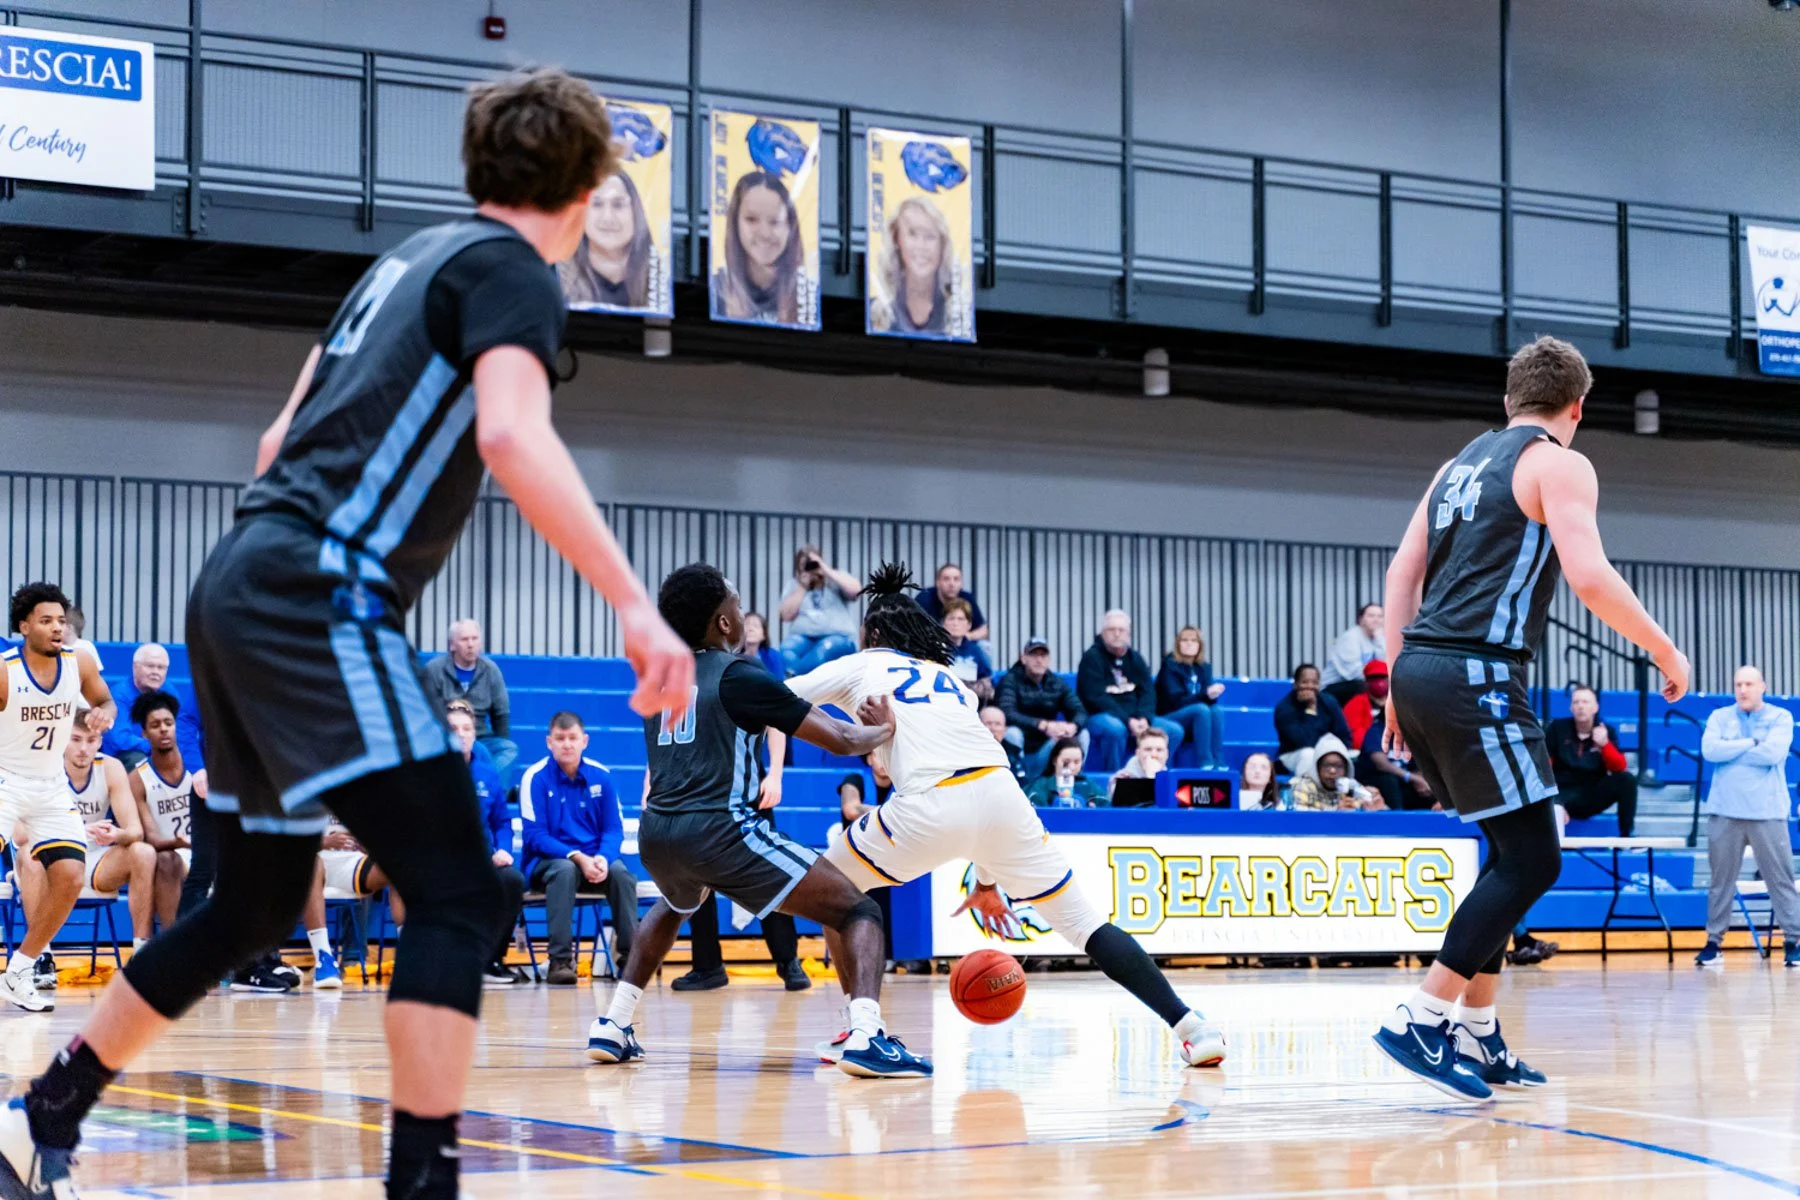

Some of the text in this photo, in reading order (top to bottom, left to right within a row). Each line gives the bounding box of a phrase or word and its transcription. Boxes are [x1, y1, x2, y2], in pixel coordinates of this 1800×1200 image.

[8, 125, 87, 163] Century
[1436, 457, 1492, 530] 34
[887, 666, 968, 707] 24
[30, 726, 56, 751] 21
[657, 684, 699, 747] 10
[1108, 846, 1455, 934] BEARCATS
